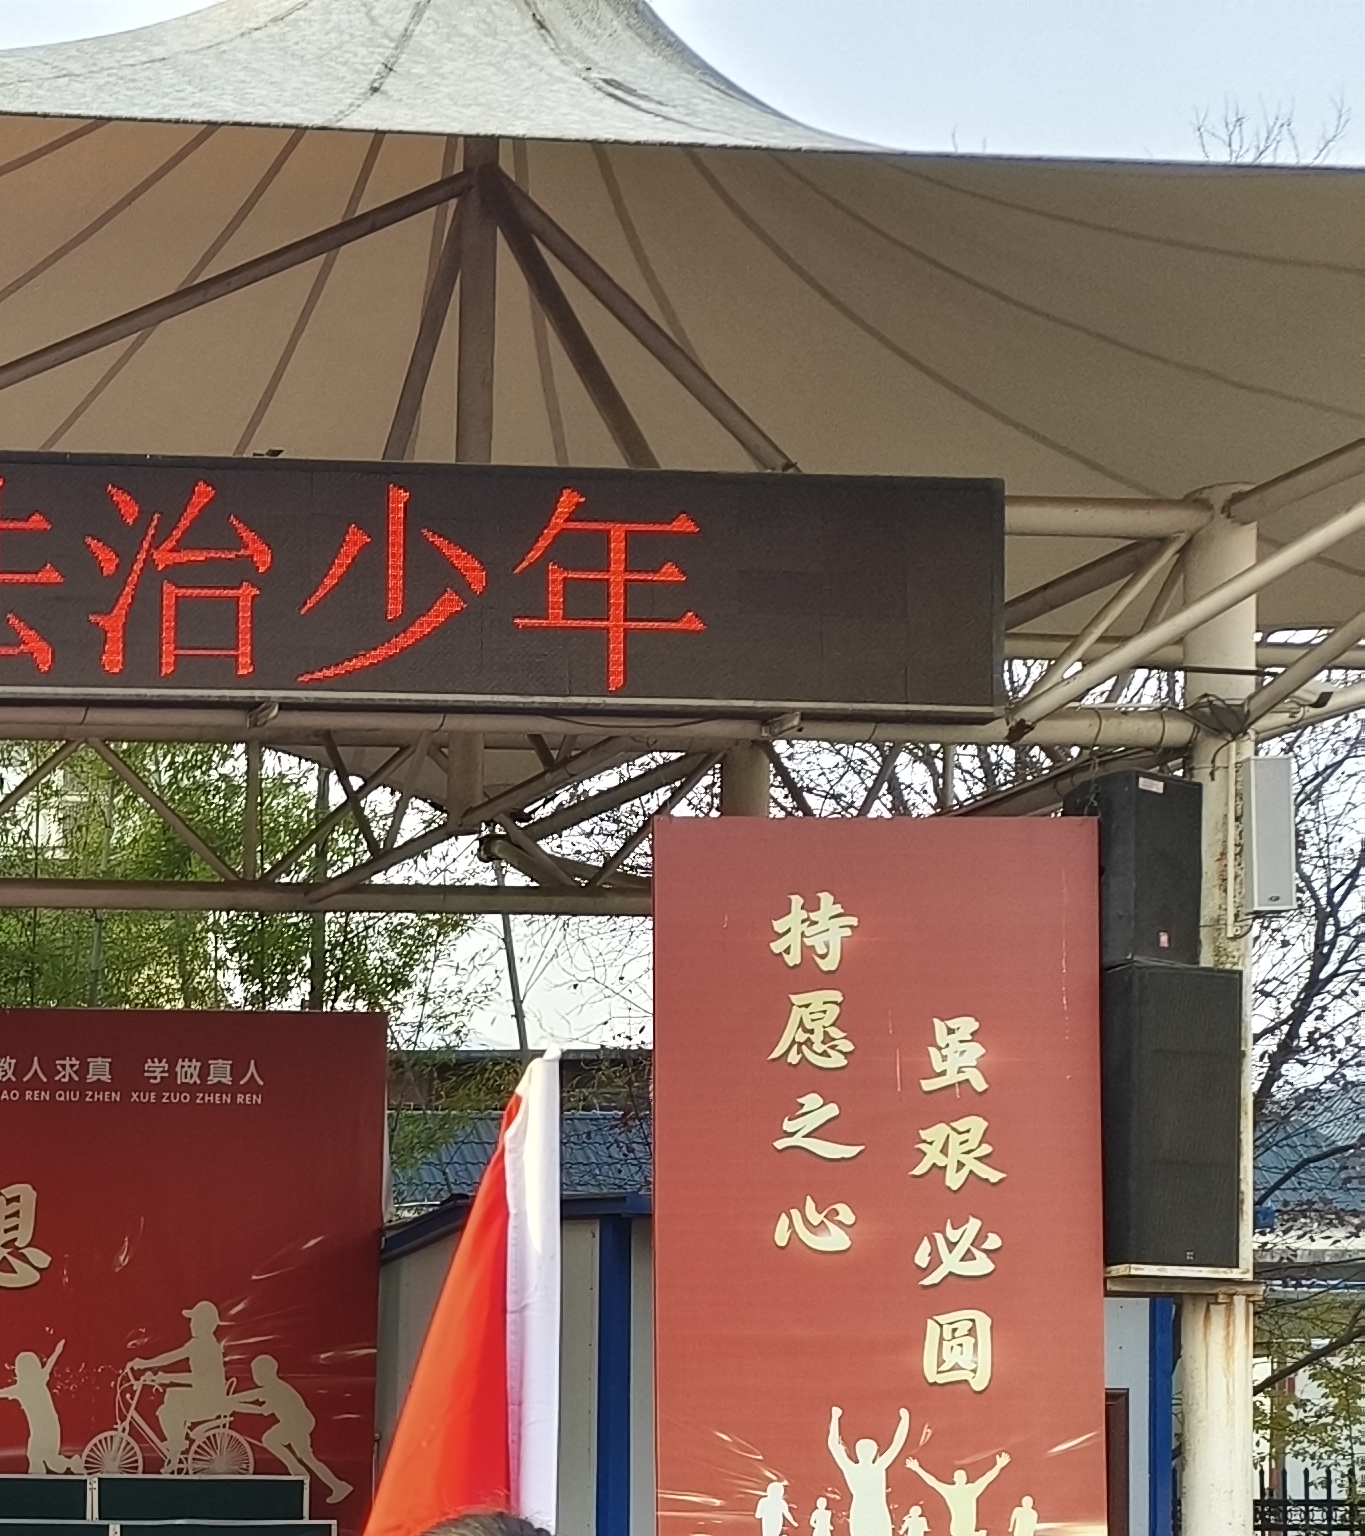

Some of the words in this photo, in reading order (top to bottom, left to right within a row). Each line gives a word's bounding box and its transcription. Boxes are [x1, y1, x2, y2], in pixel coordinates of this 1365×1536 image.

[24, 1090, 51, 1102] REN
[55, 1090, 81, 1103] QIU
[84, 1090, 122, 1103] ZHEN
[130, 1091, 157, 1104] XUE
[161, 1092, 191, 1104] ZUO
[195, 1092, 232, 1105] ZHEN
[236, 1093, 263, 1105] REN
[143, 1057, 265, 1086] 学做真人
[768, 890, 866, 1253] 持愿之心
[908, 1015, 1008, 1393] 虽艰必圆
